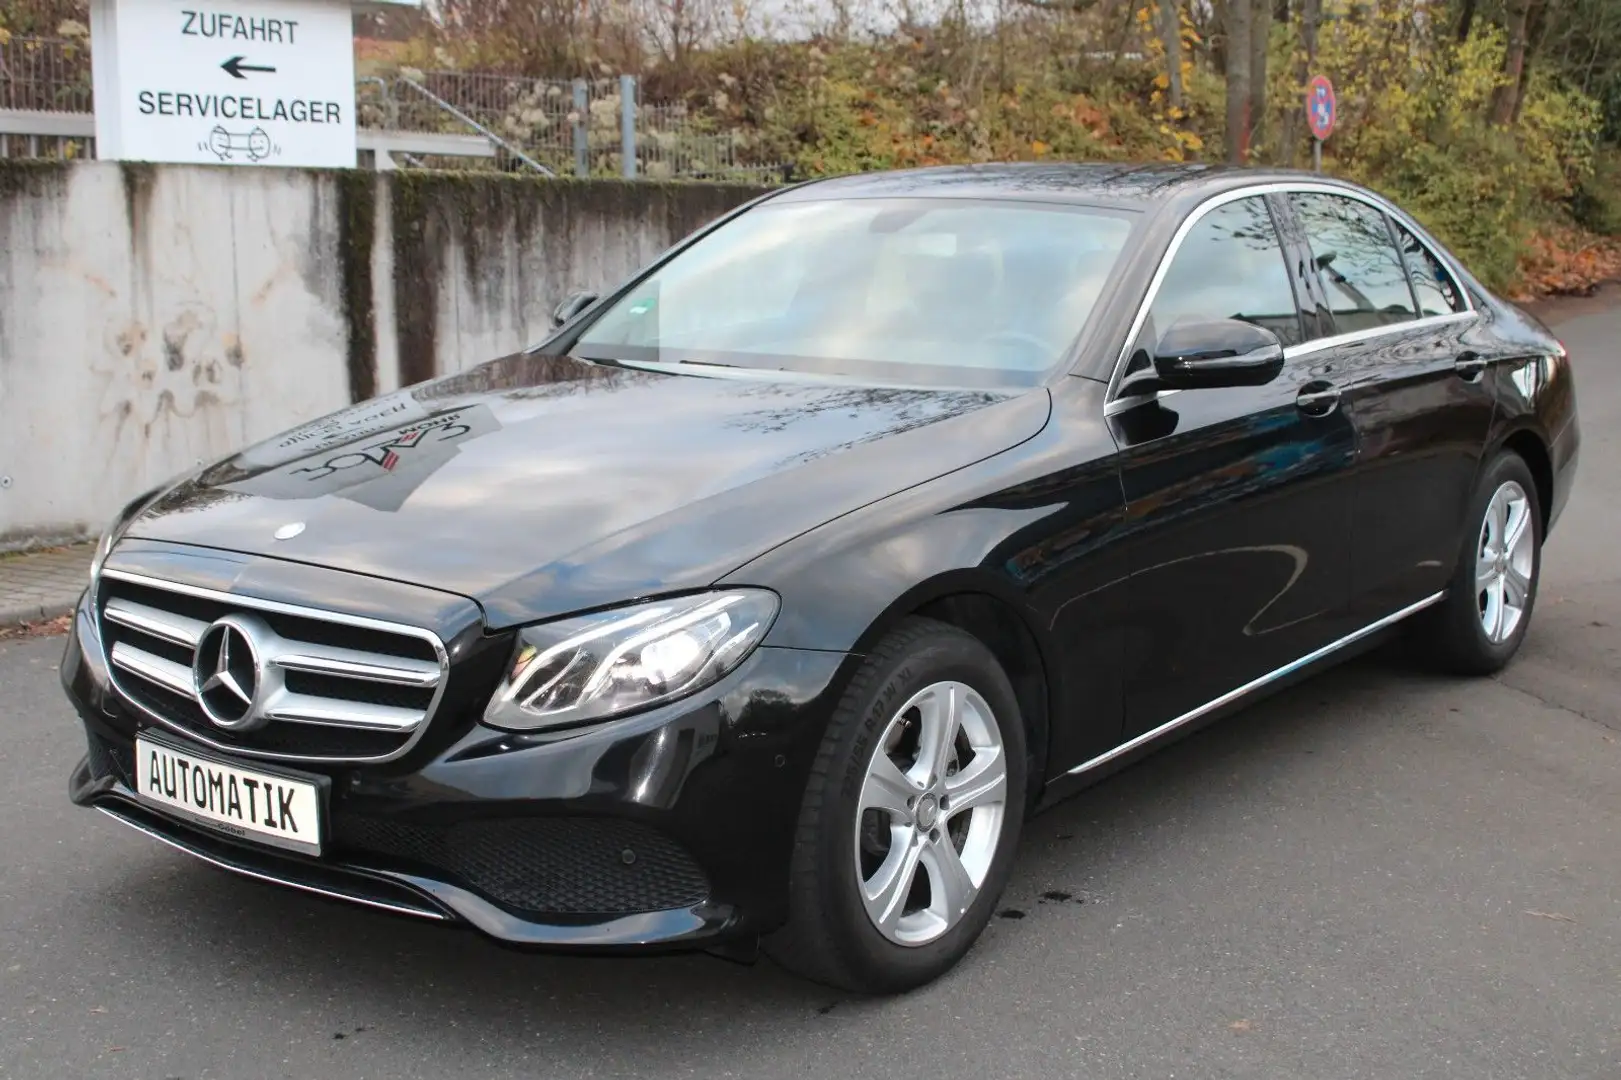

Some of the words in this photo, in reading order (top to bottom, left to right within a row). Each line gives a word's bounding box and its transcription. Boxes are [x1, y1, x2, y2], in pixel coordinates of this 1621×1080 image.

[181, 10, 299, 44] ZUFAHRT
[138, 90, 341, 124] SERVICELAGER
[150, 750, 299, 833] AUTOMATIK
